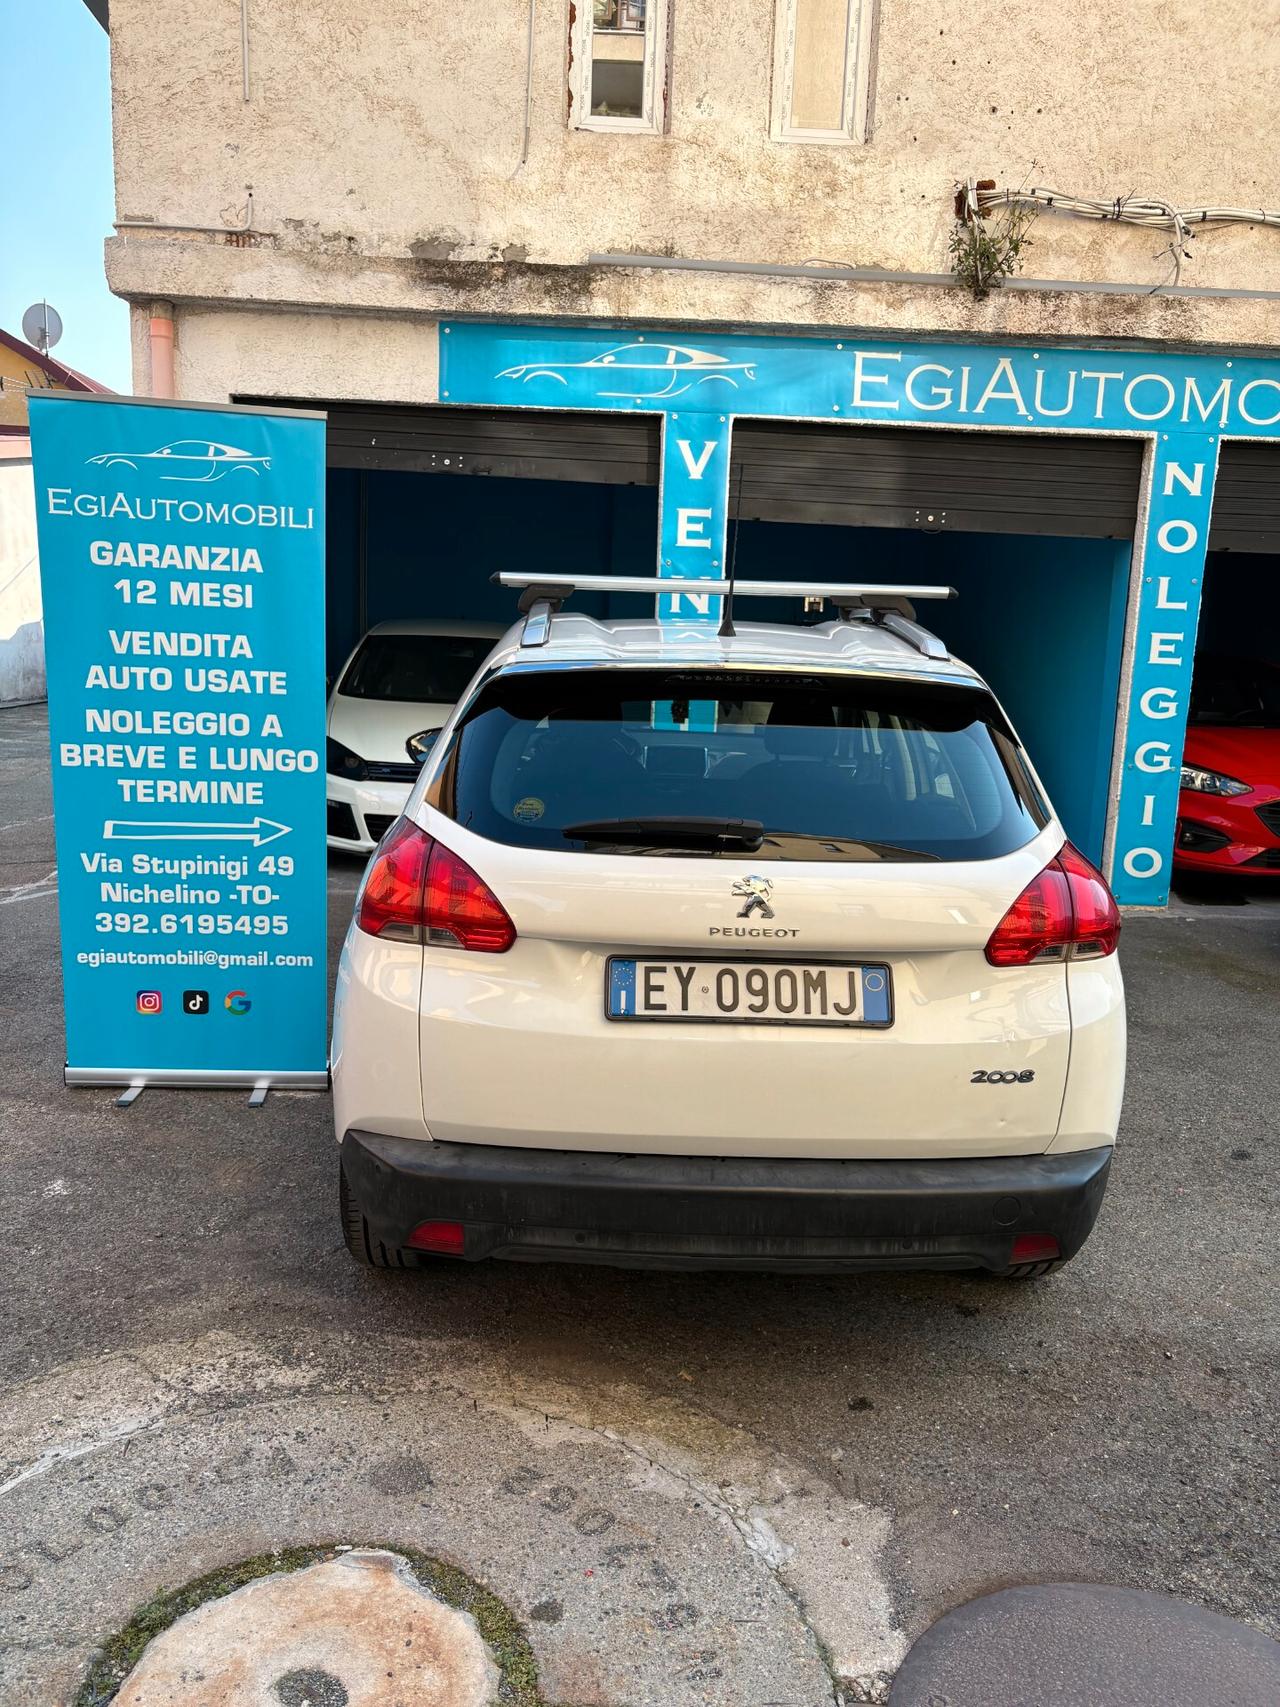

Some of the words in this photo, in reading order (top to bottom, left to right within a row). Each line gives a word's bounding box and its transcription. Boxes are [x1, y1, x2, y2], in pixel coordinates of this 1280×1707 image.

[89, 540, 264, 573] GARANZIA
[114, 578, 157, 605] 12
[170, 581, 253, 609] MESI
[108, 629, 253, 659] VENDITA
[85, 665, 173, 691] AUTO
[184, 668, 287, 695] USATE
[1123, 462, 1205, 878] NOLEGGIO
[85, 709, 250, 737] NOLEGGIO
[260, 714, 283, 738] A
[60, 743, 166, 769] BREVE
[178, 746, 197, 770] E
[209, 747, 319, 773] LUNGO
[117, 779, 264, 805] TERMINE
[80, 852, 123, 873] Via
[132, 853, 248, 881] Stupinigi
[258, 855, 294, 876] 49
[100, 882, 221, 904] Nichelino
[229, 885, 280, 905] -TO-
[95, 912, 289, 935] 392.6195495
[709, 927, 800, 938] PEUGEOT
[77, 948, 313, 970] egiautomobili@gmail.com
[644, 966, 696, 1011] EY
[716, 968, 856, 1015] 090MJ
[970, 1069, 1036, 1084] 2008
